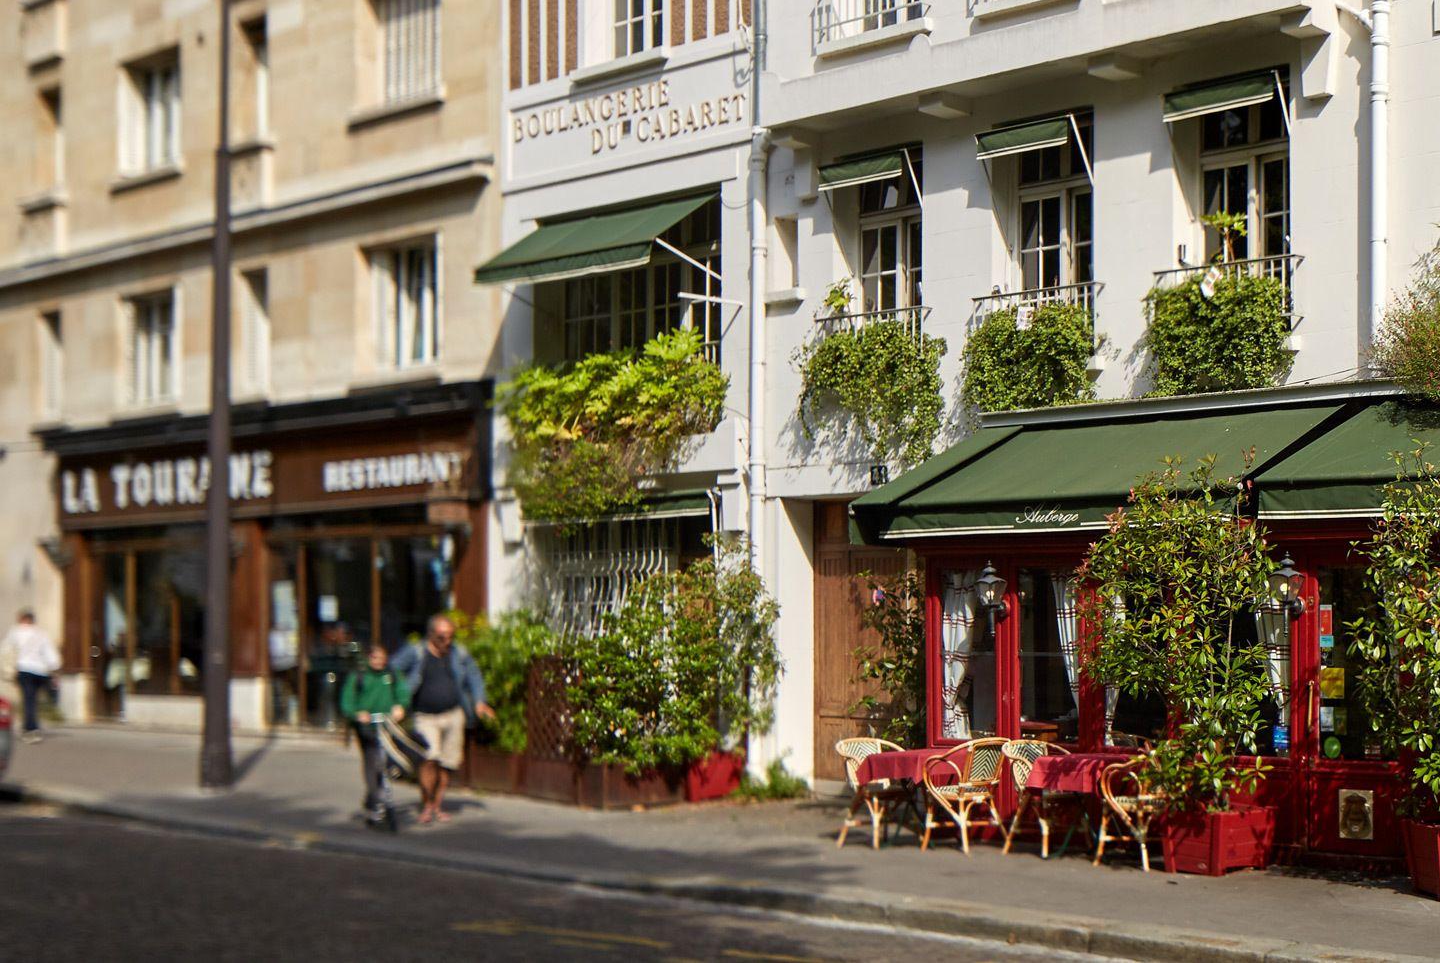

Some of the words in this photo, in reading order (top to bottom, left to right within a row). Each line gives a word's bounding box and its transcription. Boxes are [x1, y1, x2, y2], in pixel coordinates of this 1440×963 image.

[513, 80, 670, 143] BOULANGERIE
[591, 123, 620, 155] DU
[636, 93, 746, 143] CABARET
[62, 468, 100, 513] LA
[324, 451, 462, 493] RESTAURANT
[1015, 502, 1079, 526] Auberge
